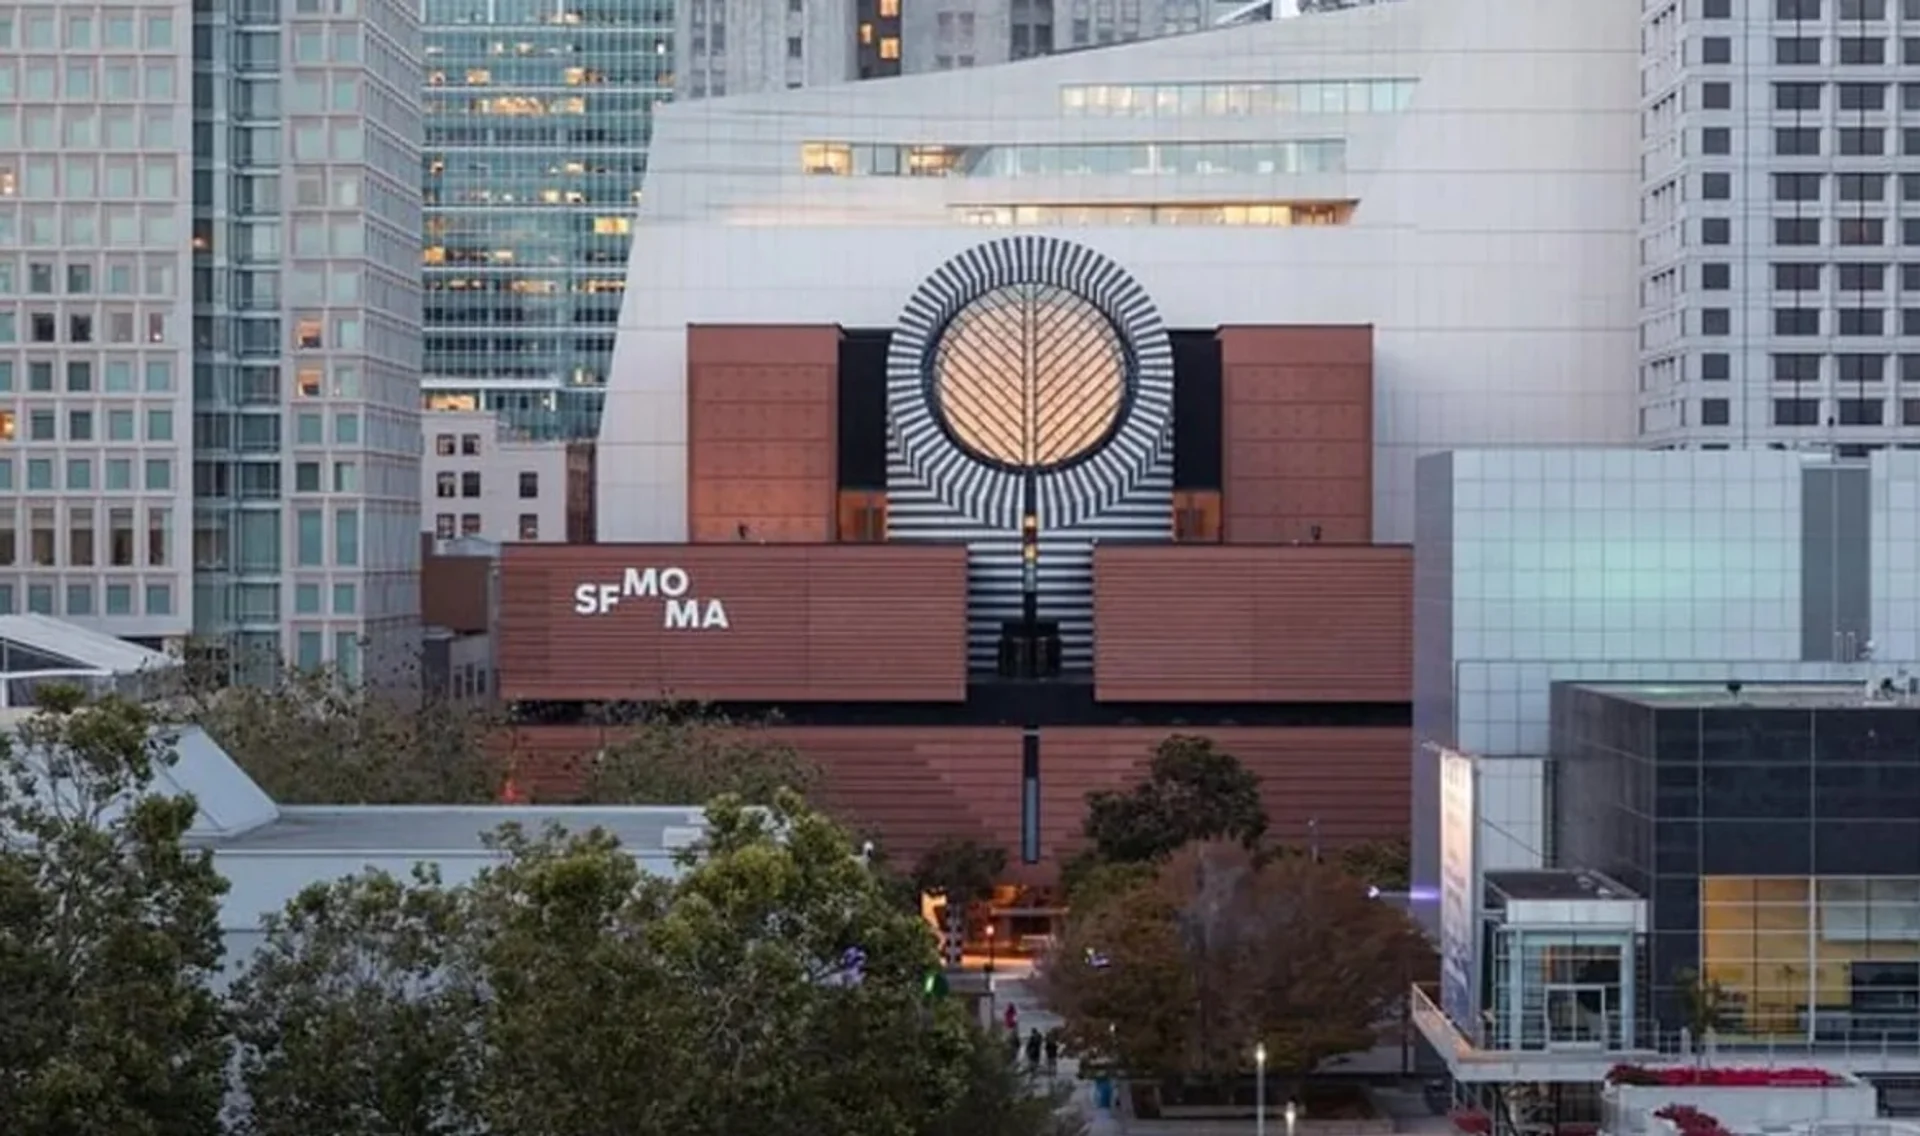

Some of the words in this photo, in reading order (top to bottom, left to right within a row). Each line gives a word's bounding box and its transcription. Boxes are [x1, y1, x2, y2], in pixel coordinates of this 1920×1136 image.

[623, 567, 688, 596] MO
[575, 583, 620, 614] SF
[665, 599, 729, 628] MA
